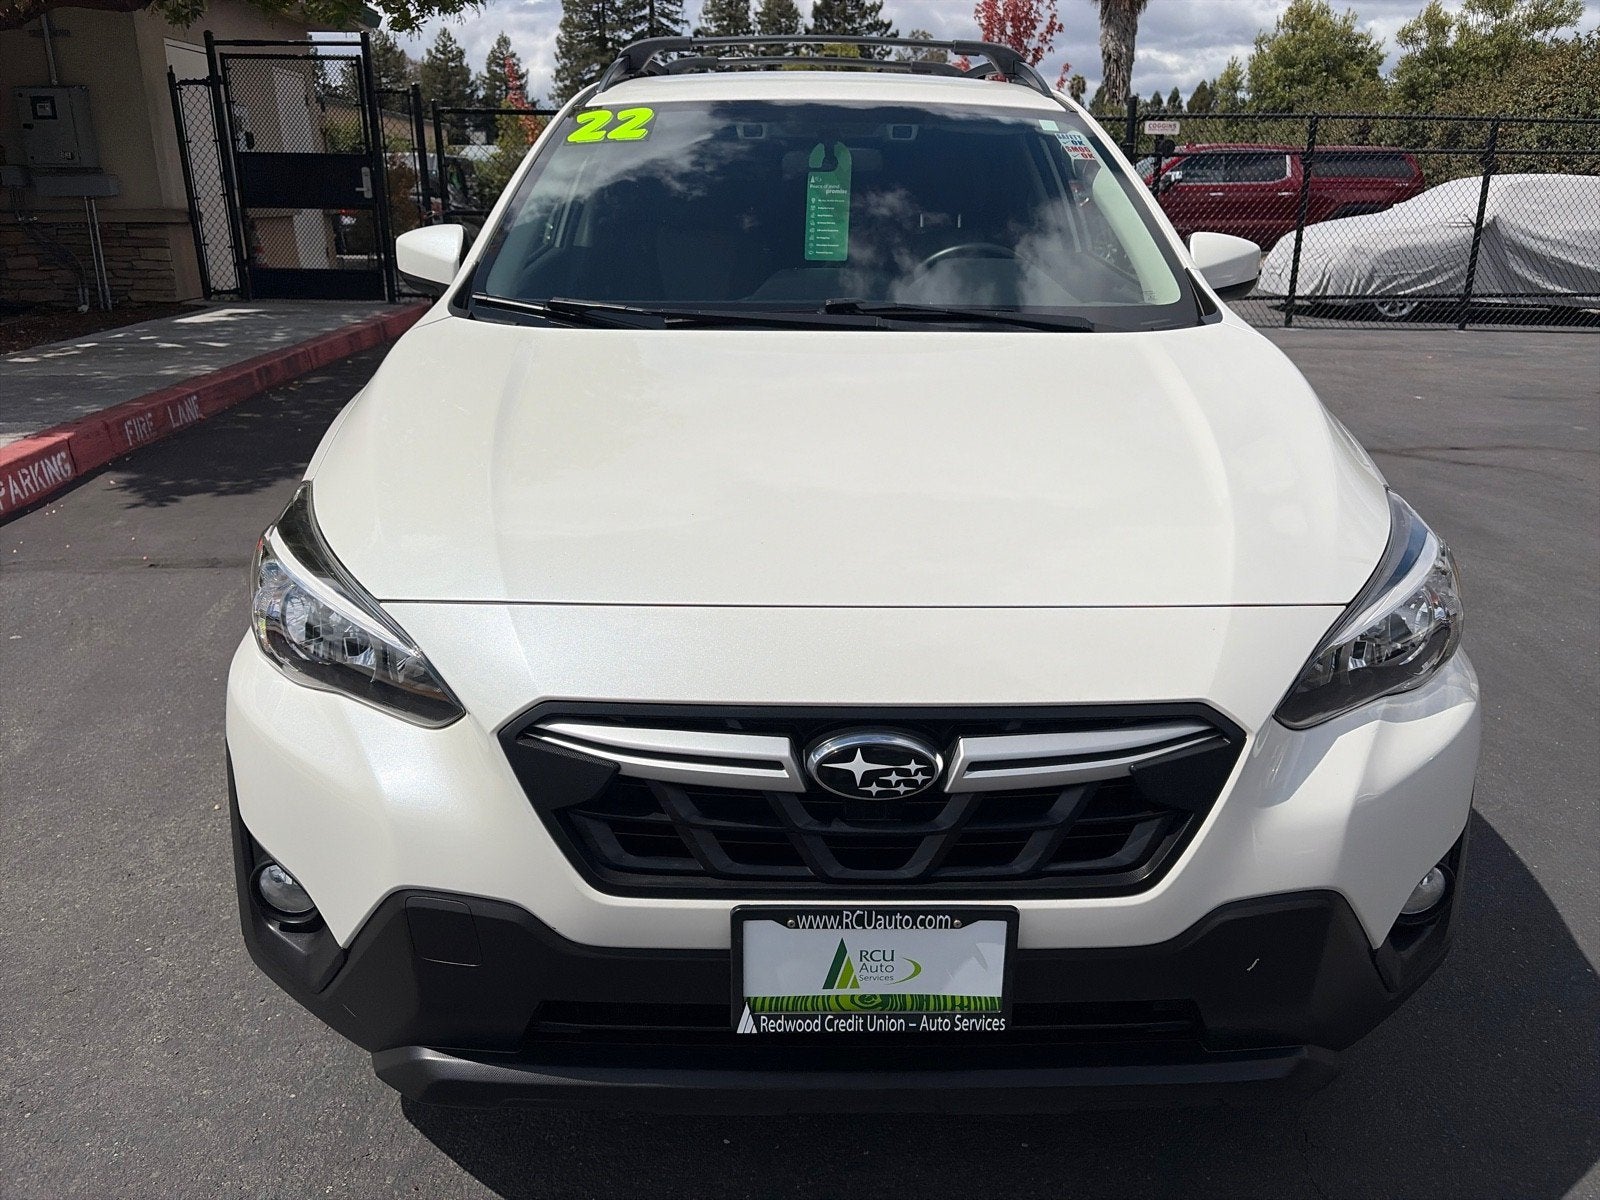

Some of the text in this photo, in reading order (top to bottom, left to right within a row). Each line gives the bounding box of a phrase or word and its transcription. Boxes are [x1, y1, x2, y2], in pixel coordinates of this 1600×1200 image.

[567, 107, 655, 143] 22
[124, 395, 201, 446] FIRE LANE
[796, 910, 951, 930] www.RCUauto.com
[859, 949, 895, 962] RCU
[859, 962, 895, 973] Auto
[760, 1014, 821, 1033] Redwood
[824, 1014, 864, 1032] Credit
[867, 1014, 906, 1032] Union
[919, 1014, 952, 1032] Auto
[954, 1014, 1006, 1031] Services
